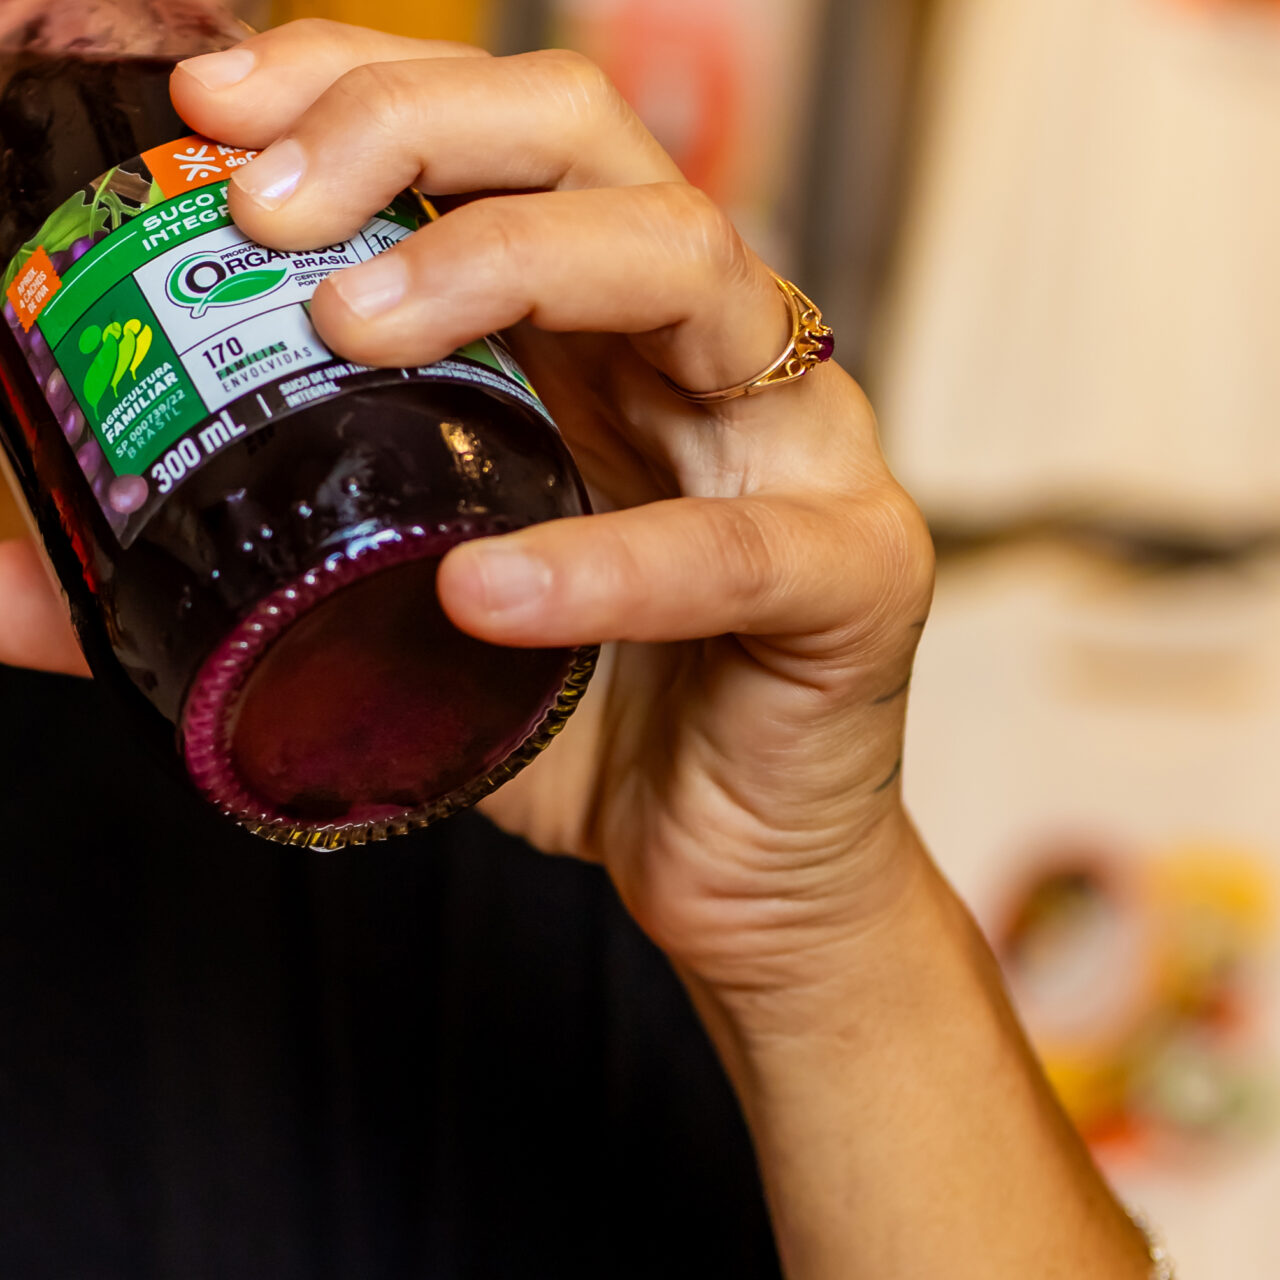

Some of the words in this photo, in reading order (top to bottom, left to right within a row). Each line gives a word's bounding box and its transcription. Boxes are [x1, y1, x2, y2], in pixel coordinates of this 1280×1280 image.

[142, 193, 215, 232] SUCO
[292, 255, 355, 270] BRASIL
[23, 270, 47, 303] CACHOS
[28, 299, 38, 314] DE
[35, 284, 49, 303] UVA
[298, 279, 318, 288] POR
[202, 336, 244, 369] 170
[222, 346, 312, 393] ENVOLVIDAS
[278, 375, 311, 396] SUCO
[308, 370, 326, 384] DE
[324, 364, 350, 380] UVA
[100, 362, 173, 434] AGRICULTURA
[105, 371, 178, 444] FAMILIAR
[116, 440, 129, 458] SP
[127, 407, 182, 459] BRASIL
[151, 437, 201, 494] 300
[198, 410, 246, 454] mL
